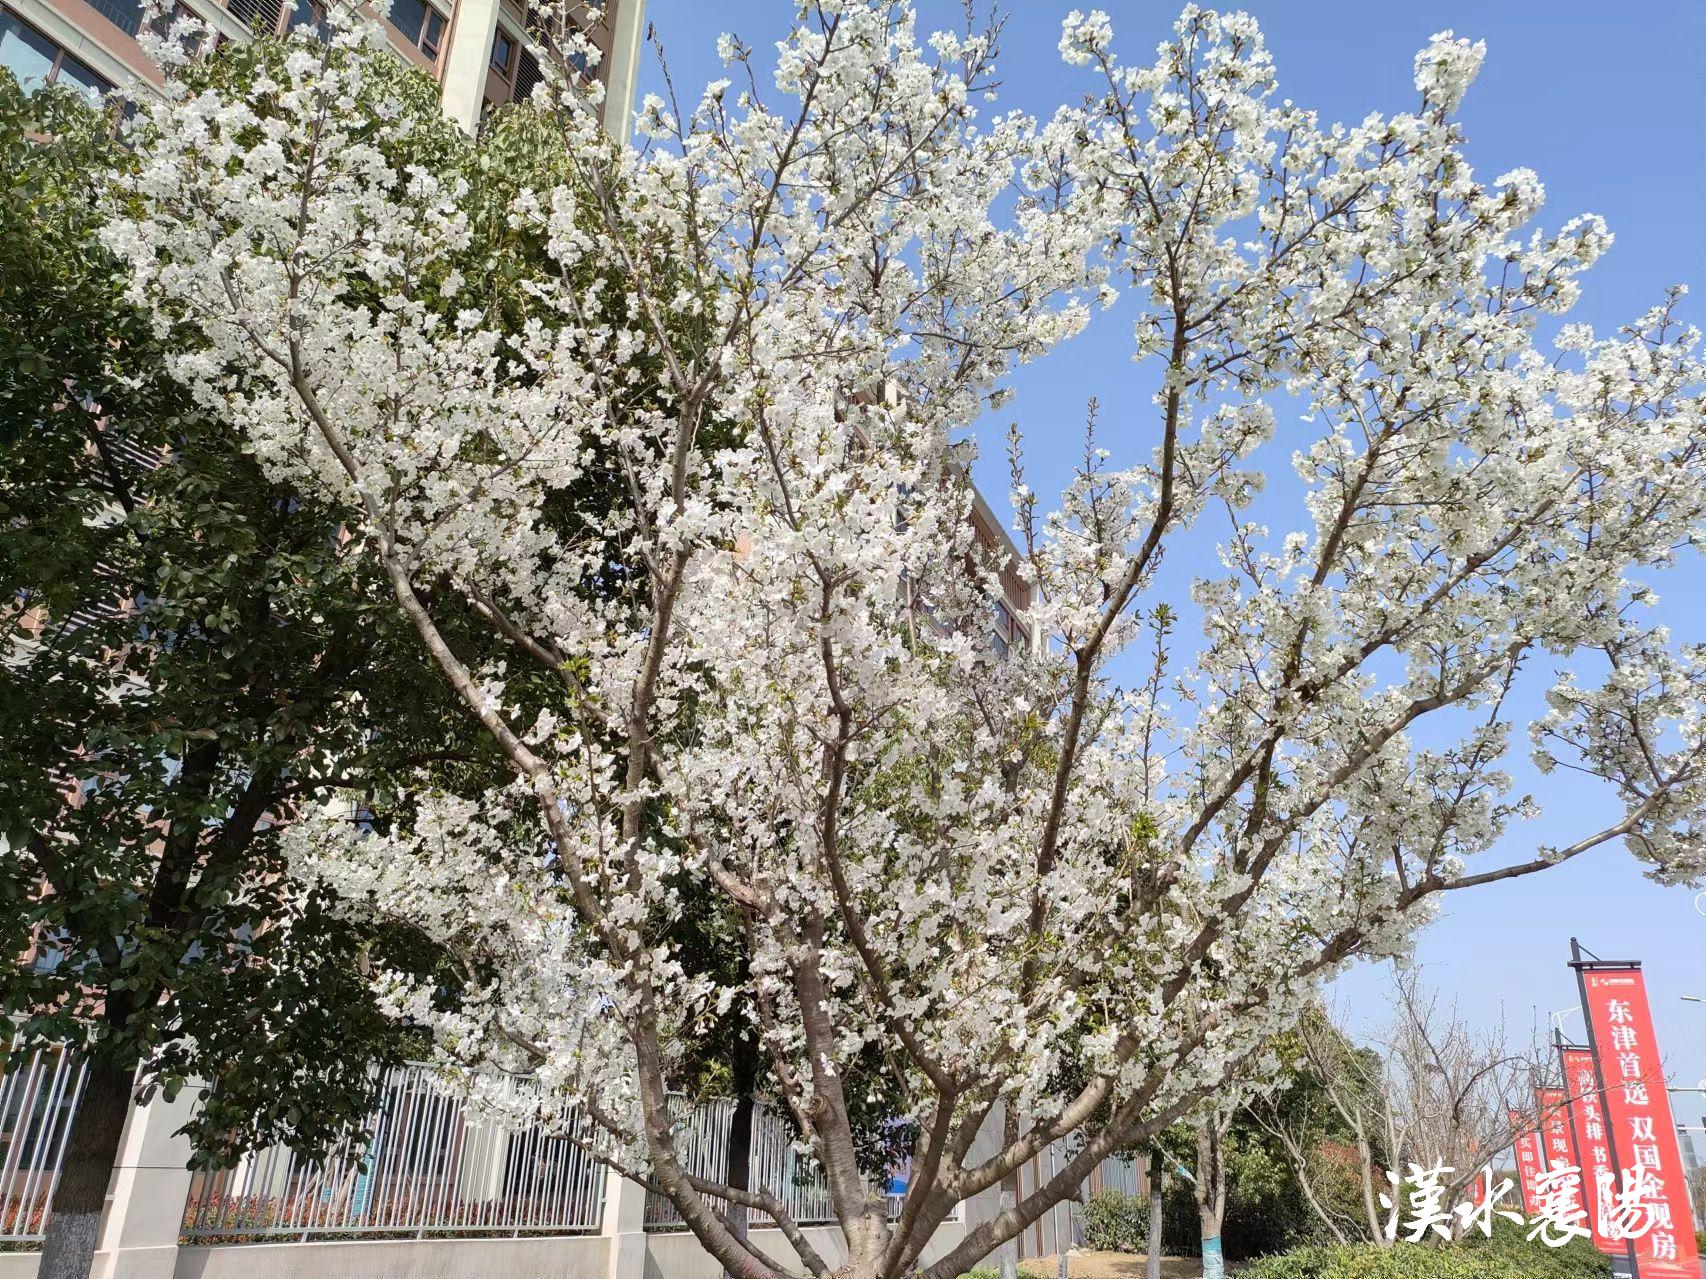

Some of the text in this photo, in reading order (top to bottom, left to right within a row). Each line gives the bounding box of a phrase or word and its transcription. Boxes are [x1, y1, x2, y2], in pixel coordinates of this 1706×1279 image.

[1605, 998, 1649, 1106] 东津首选
[1626, 1115, 1677, 1260] 双国企现房
